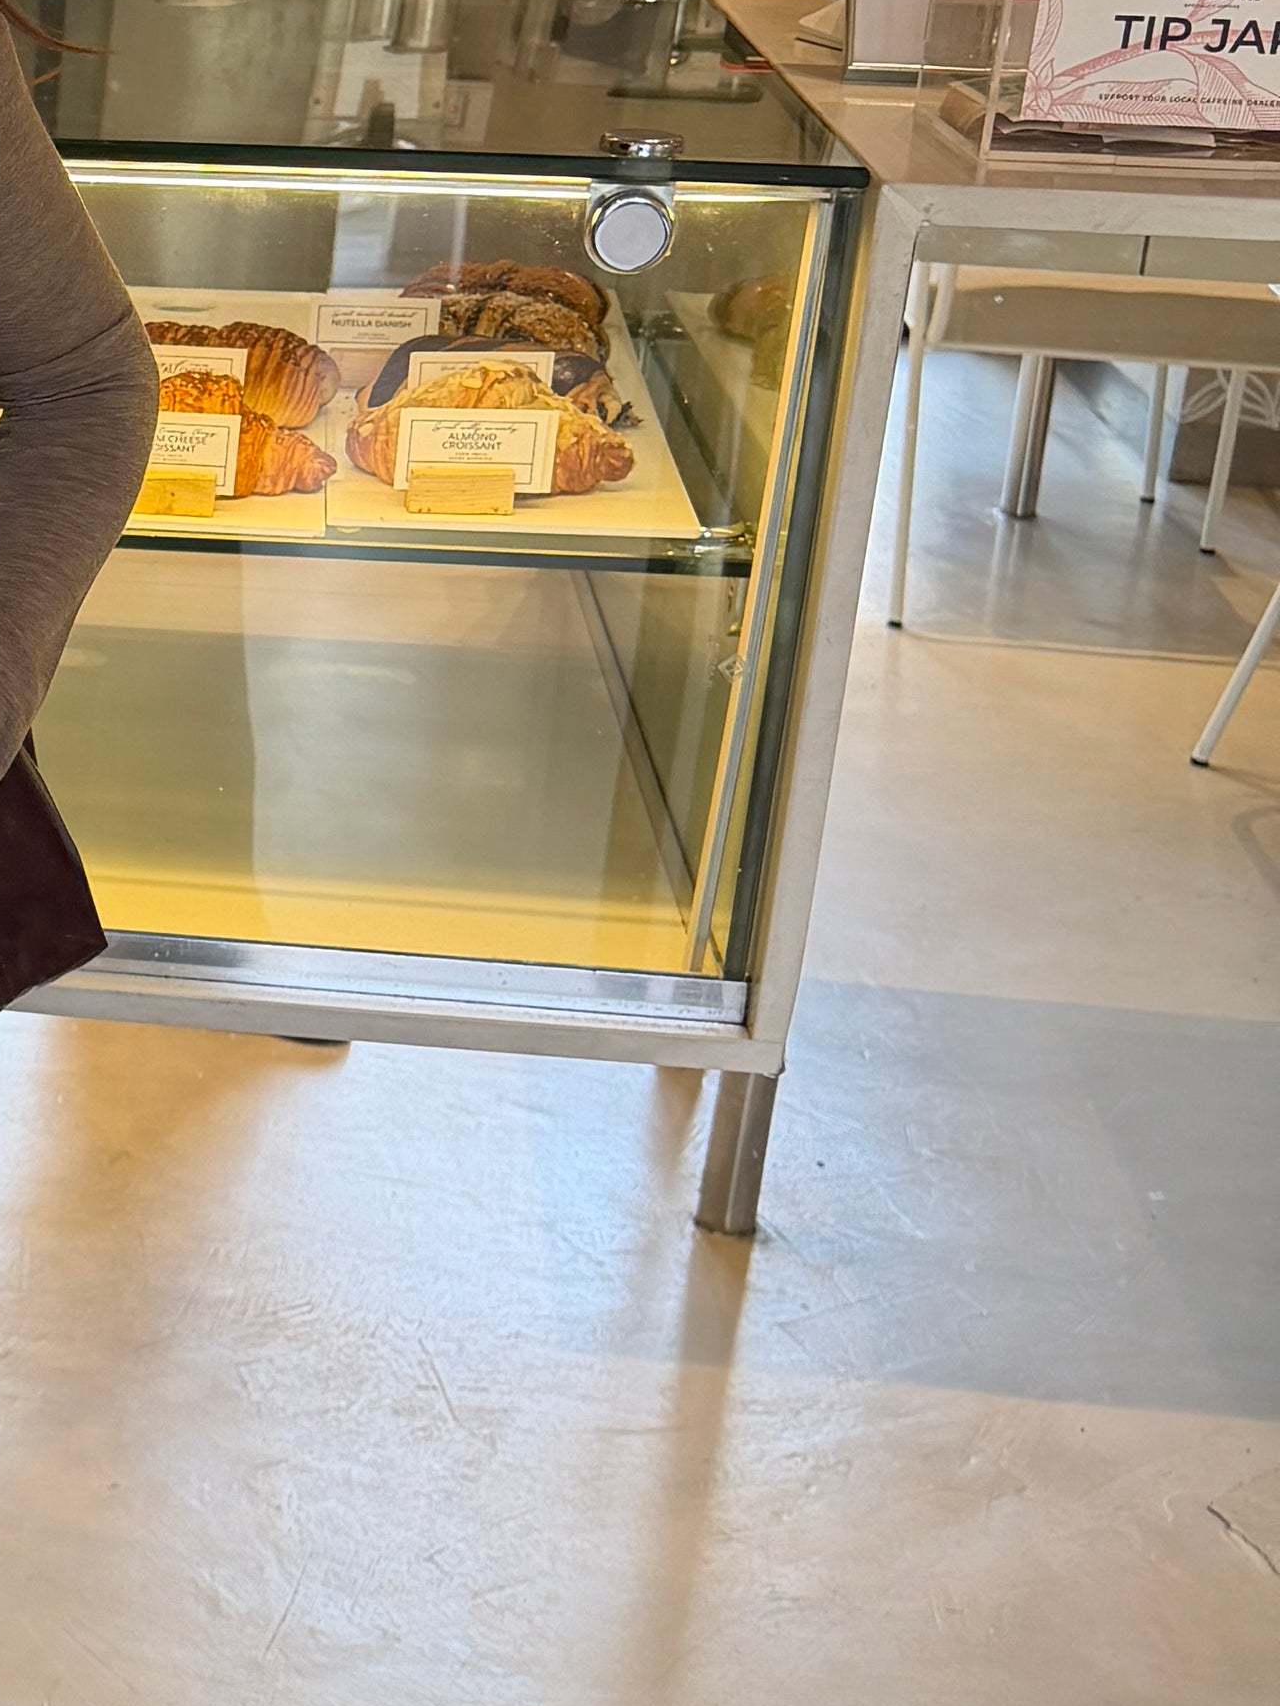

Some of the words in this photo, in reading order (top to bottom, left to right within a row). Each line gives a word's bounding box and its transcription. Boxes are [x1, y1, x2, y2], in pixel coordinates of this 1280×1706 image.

[1115, 15, 1191, 51] TIP
[331, 318, 372, 327] NUTELLA
[448, 432, 497, 441] ALMOND
[442, 440, 502, 450] CROISSANT
